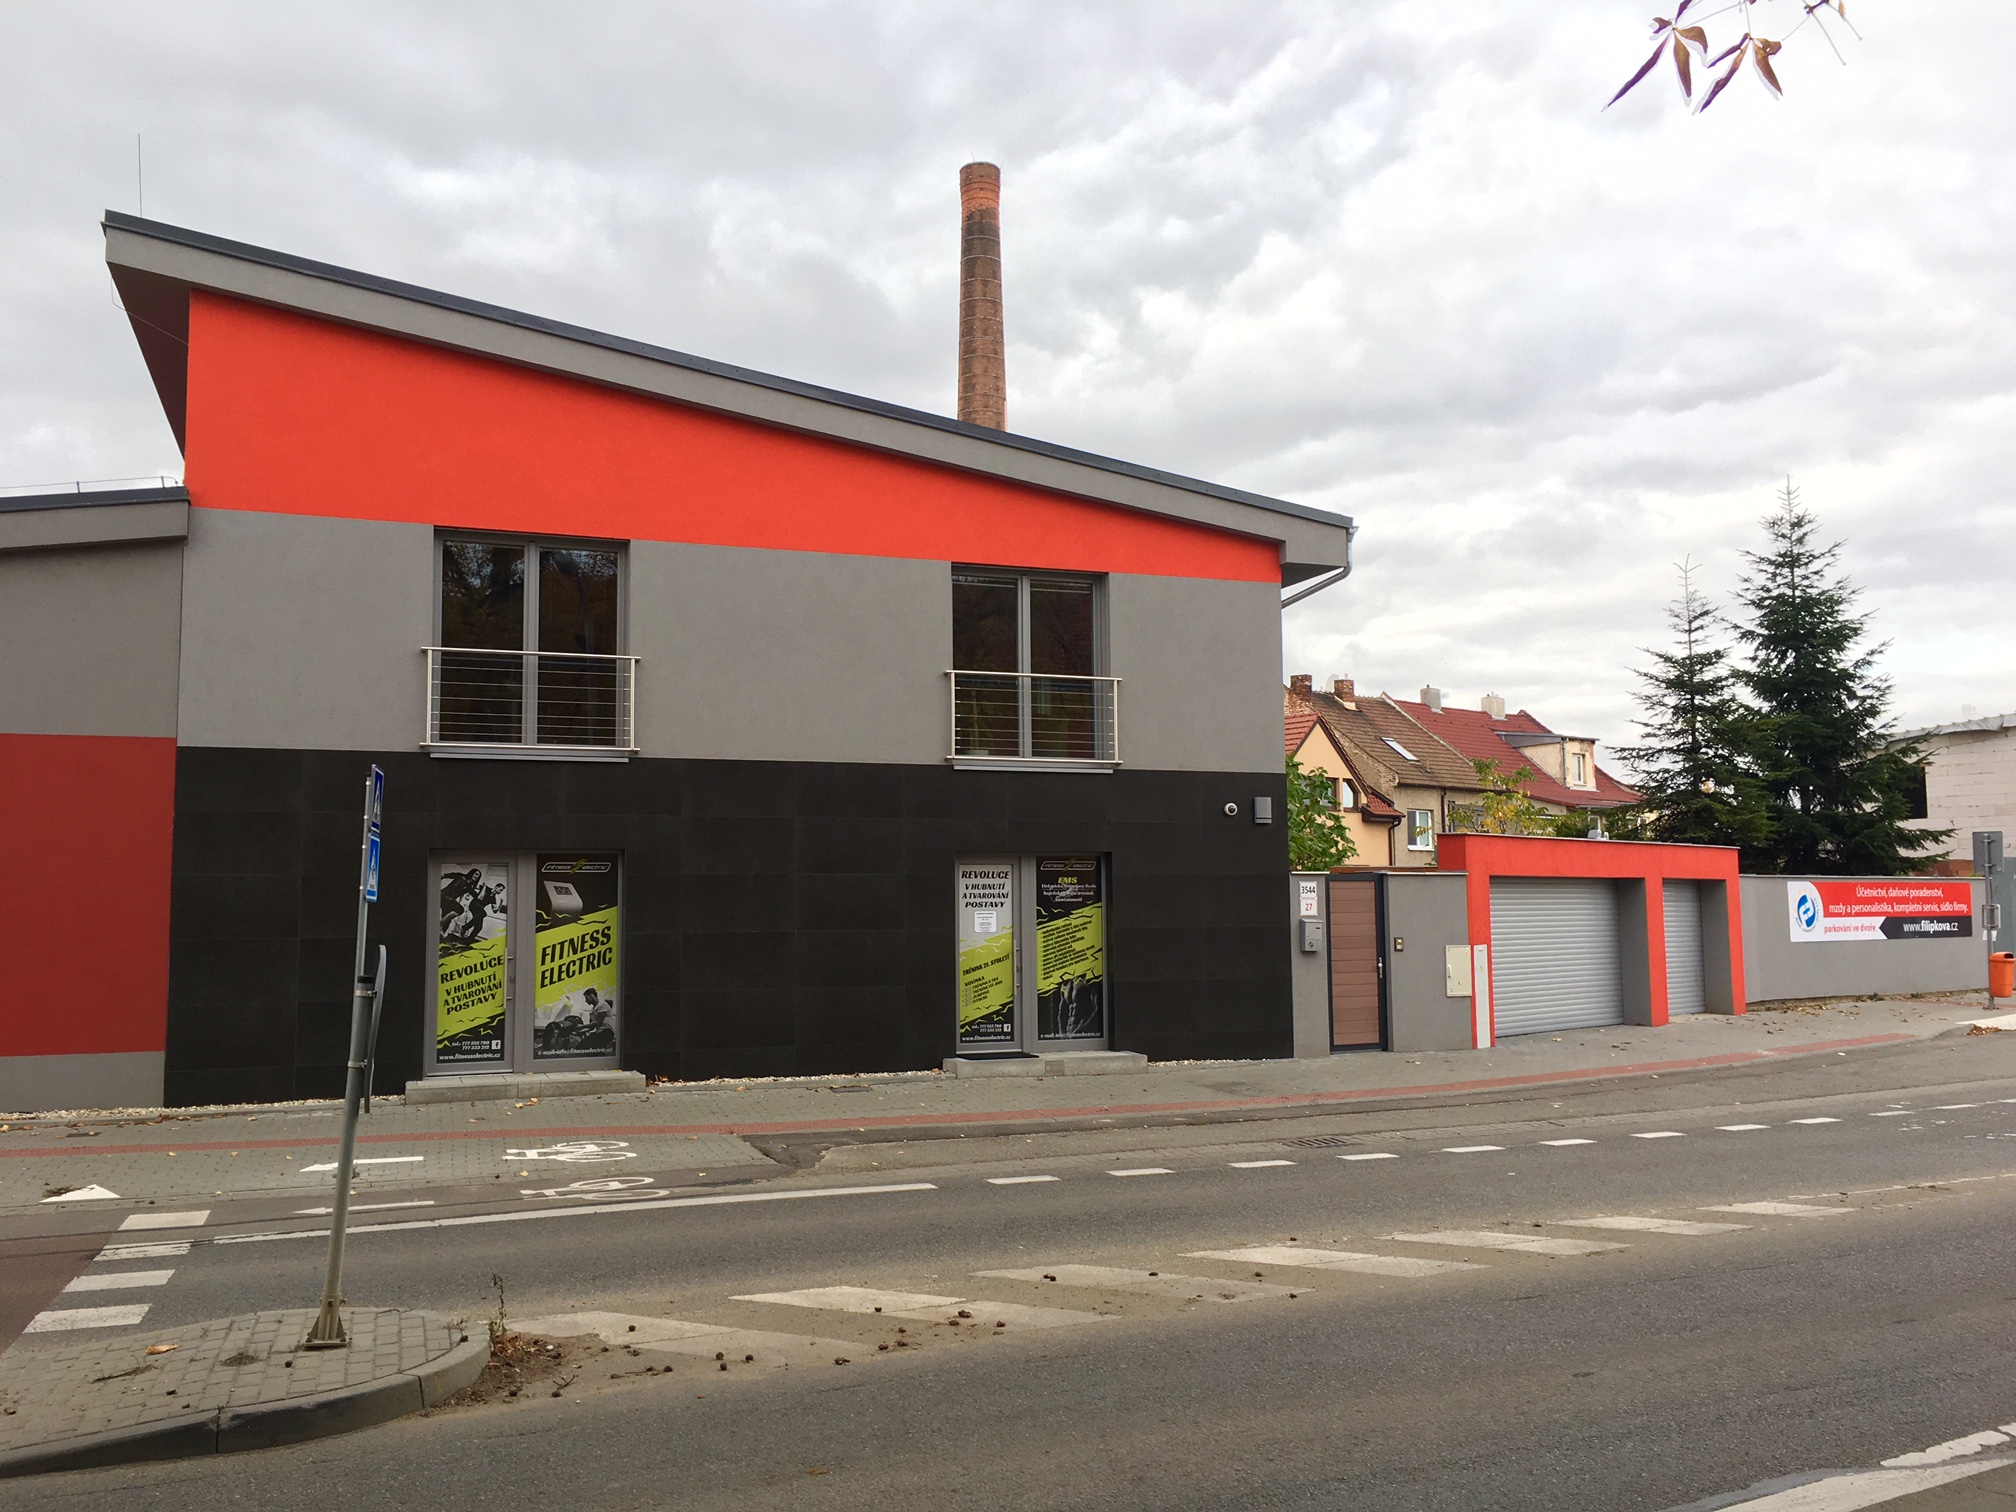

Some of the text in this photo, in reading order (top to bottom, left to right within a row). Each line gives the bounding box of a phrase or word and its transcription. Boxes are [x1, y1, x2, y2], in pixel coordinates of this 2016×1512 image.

[961, 870, 1010, 879] REVOLUCE
[971, 882, 1005, 890] HUBNUTÍ
[1301, 886, 1315, 894] 3544
[1856, 885, 1943, 898] Účetnictví, daňové poradenství,
[968, 891, 1009, 899] TVAROVÁNÍ
[1305, 903, 1312, 911] 27
[1829, 904, 1846, 916] mzdy
[1852, 902, 1893, 915] personalistika,
[1894, 902, 1922, 914] kompletní
[1923, 902, 1940, 913] servis,
[1940, 902, 1952, 912] sídlo
[1953, 902, 1968, 914] firmy.
[1824, 923, 1851, 934] parkování
[1860, 923, 1876, 932] dvoře
[1903, 920, 1958, 934] www.filipkova.cz
[541, 926, 611, 966] FITNESS
[440, 955, 504, 984] REVOLUCE
[540, 947, 612, 988] ELECTRIC
[445, 971, 496, 996] V HUBNUTÍ
[443, 979, 502, 1007] A TVAROVÁNÍ
[446, 992, 497, 1015] POSTAVY
